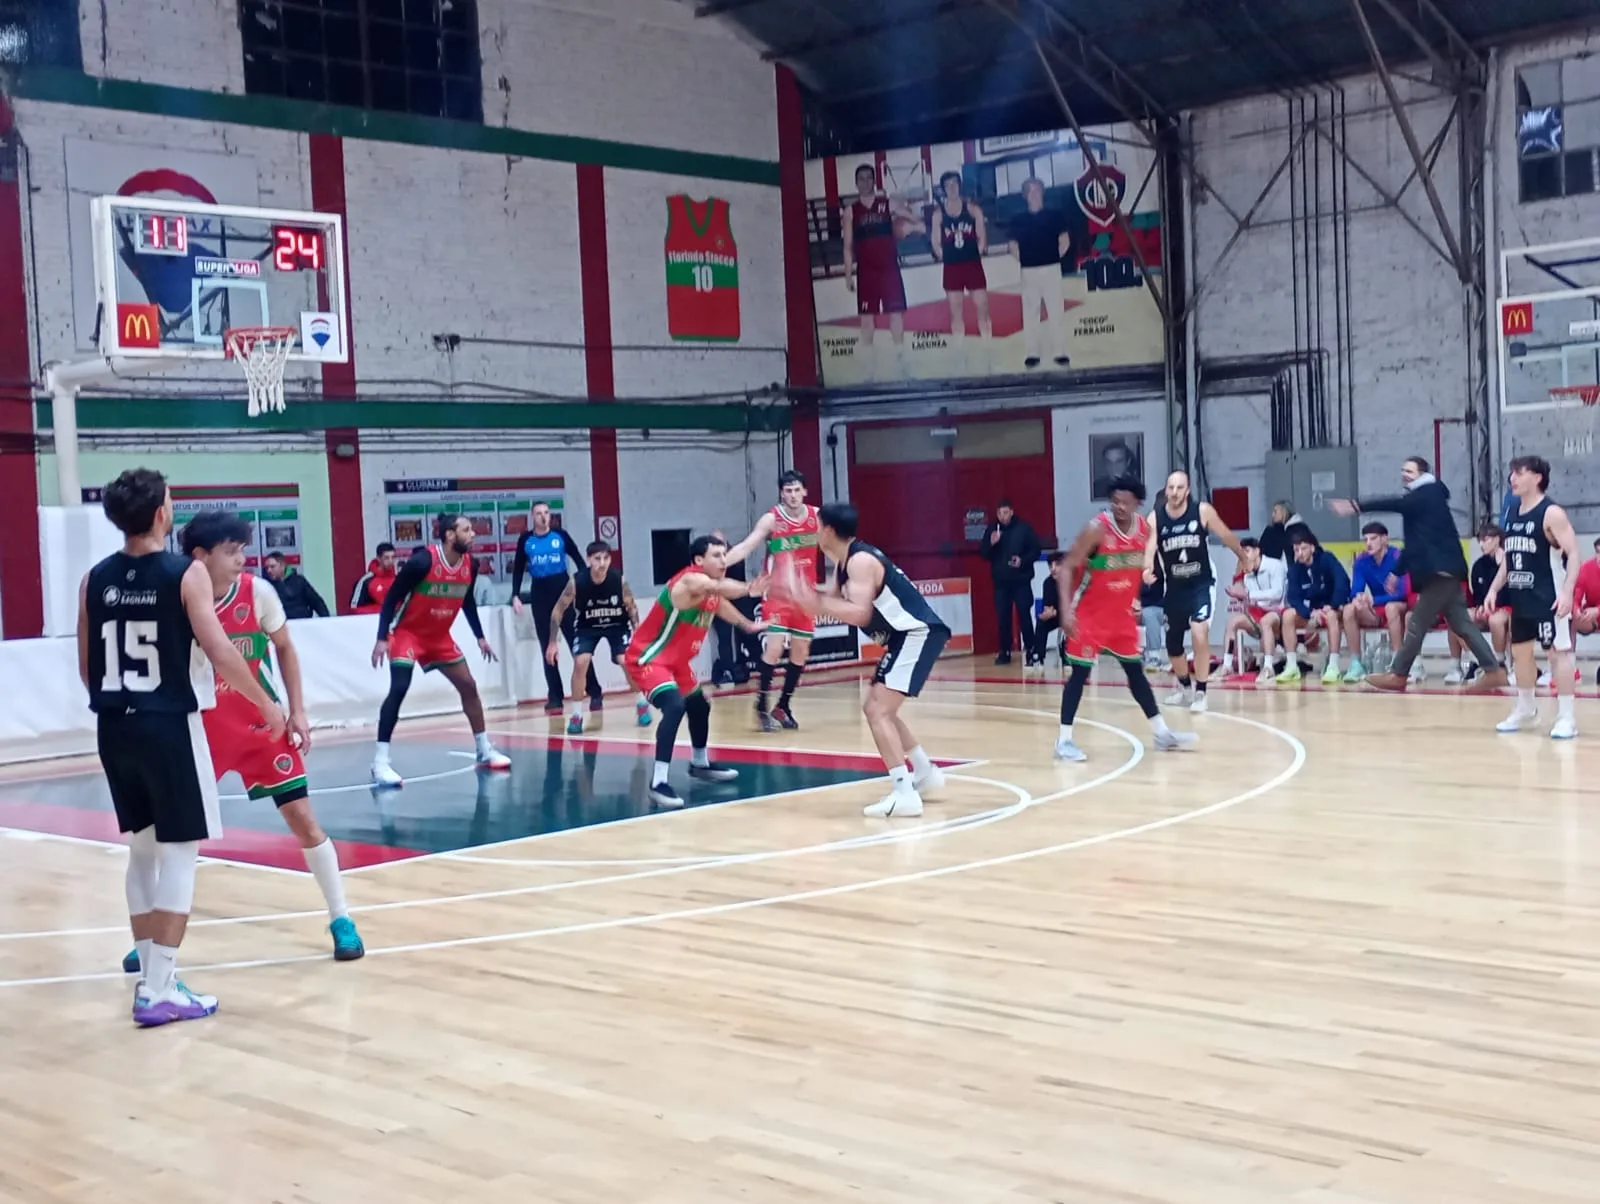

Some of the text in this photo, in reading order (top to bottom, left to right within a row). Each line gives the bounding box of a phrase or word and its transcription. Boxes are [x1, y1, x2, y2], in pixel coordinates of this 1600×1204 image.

[276, 230, 319, 270] 24
[691, 265, 714, 293] 10
[1161, 533, 1201, 553] LINIERS
[1178, 548, 1188, 564] 4
[101, 619, 163, 693] 15
